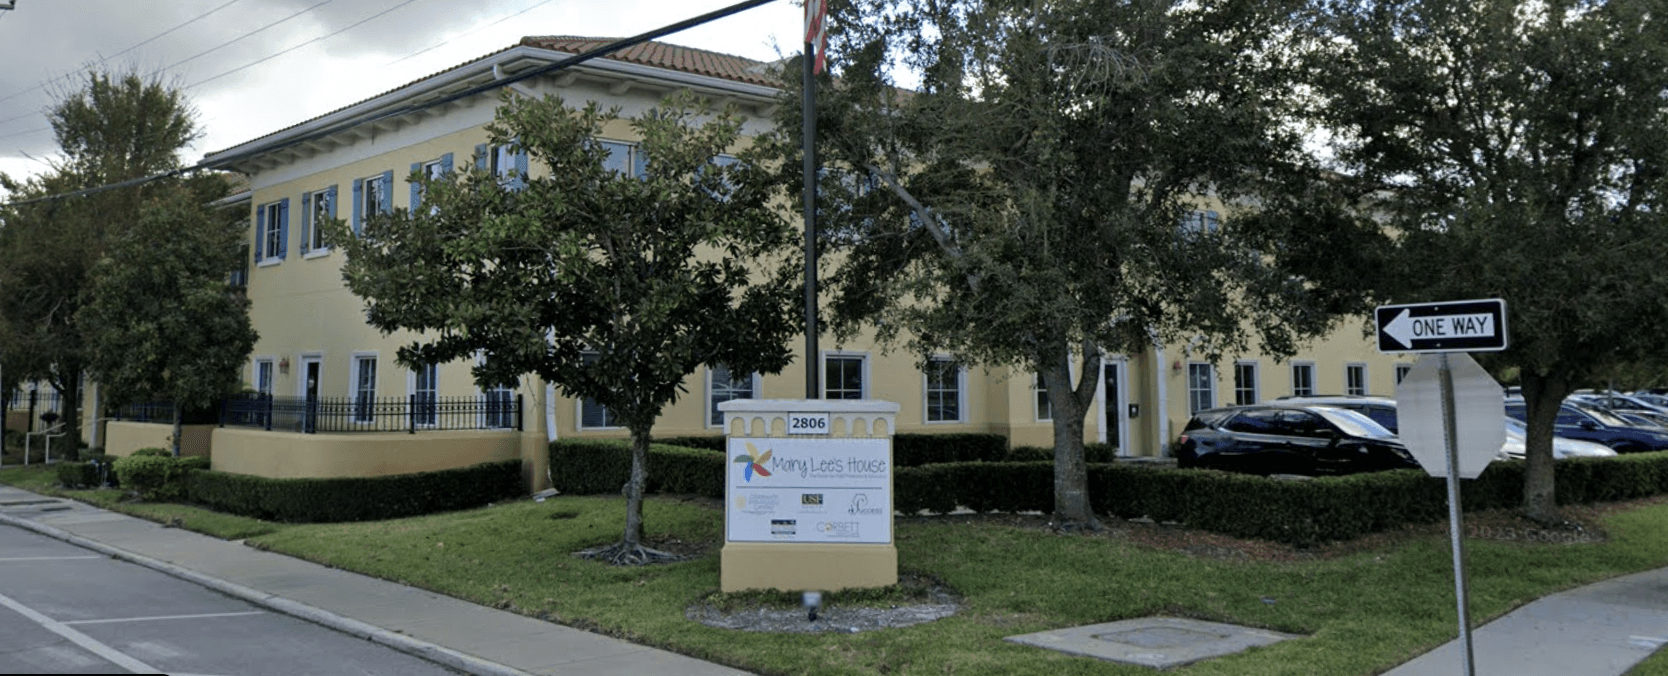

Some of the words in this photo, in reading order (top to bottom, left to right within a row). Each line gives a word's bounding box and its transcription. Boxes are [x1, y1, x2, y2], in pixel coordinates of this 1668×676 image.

[1412, 319, 1446, 337] ONE
[1452, 316, 1488, 335] WAY
[792, 417, 826, 429] 2806
[772, 456, 808, 479] Mary
[810, 457, 844, 473] Lee's
[848, 457, 887, 473] House
[803, 494, 822, 504] USF
